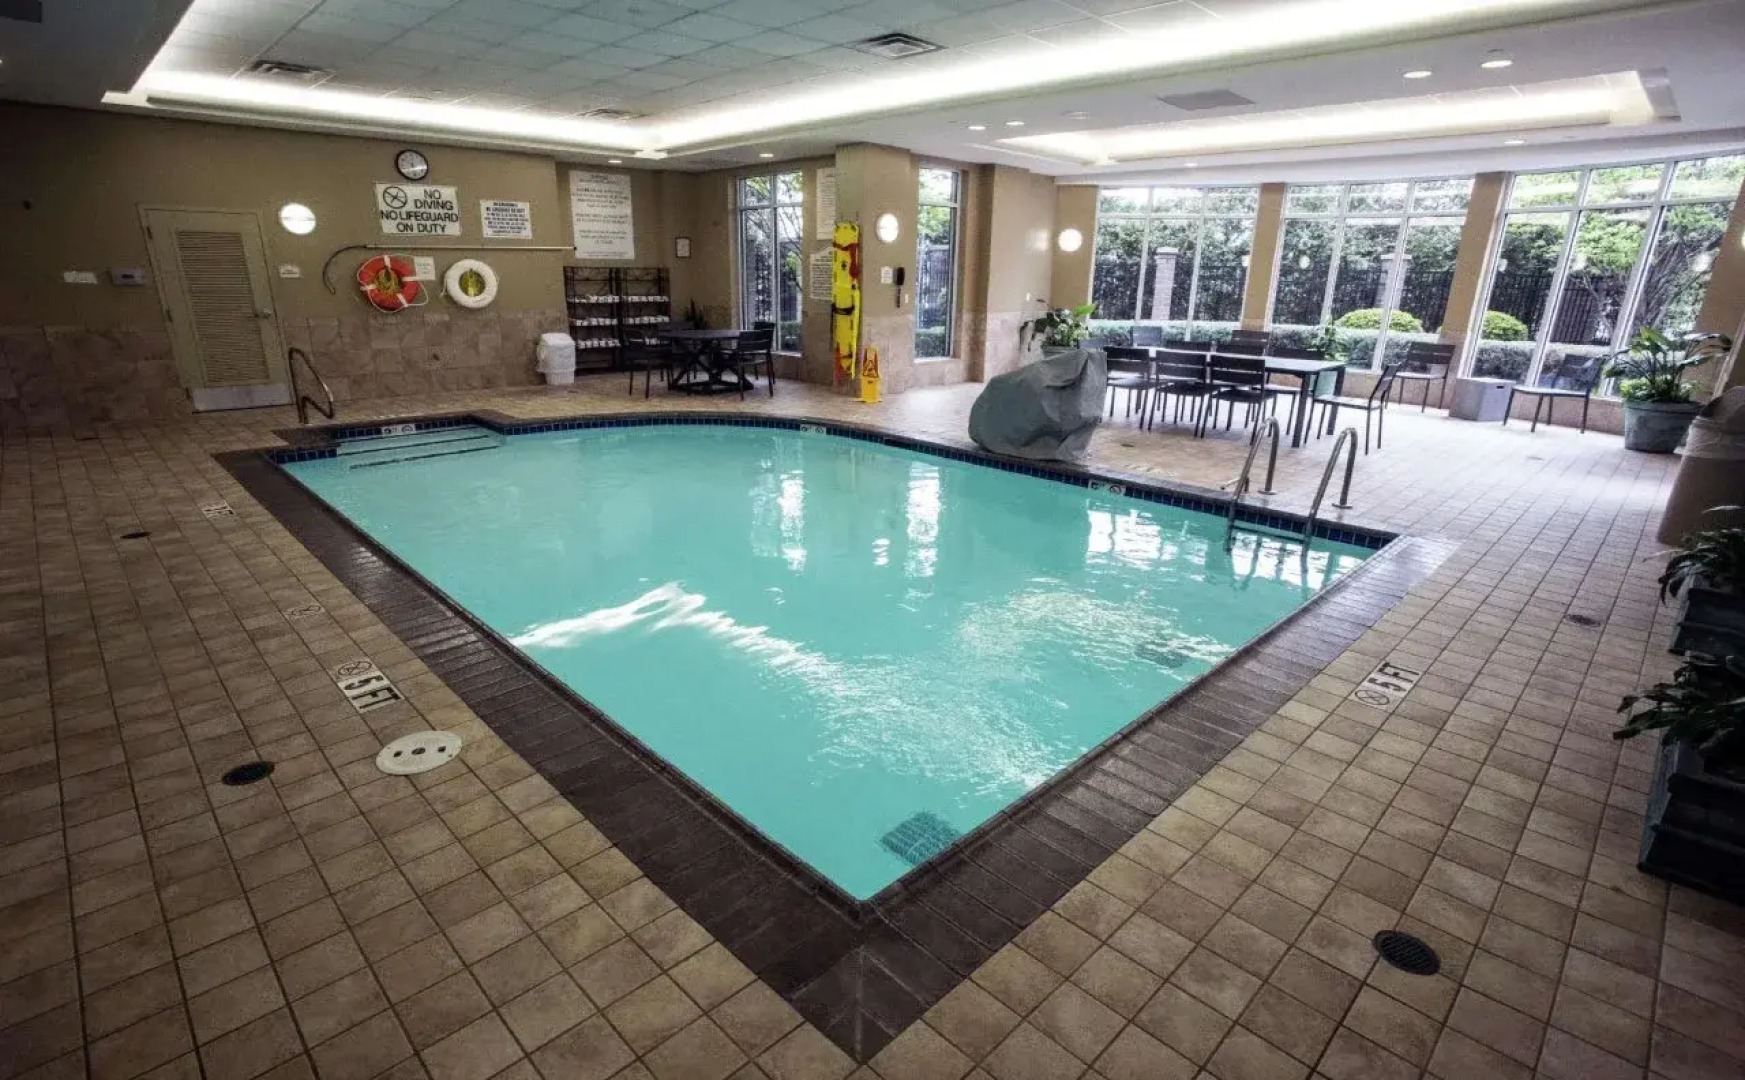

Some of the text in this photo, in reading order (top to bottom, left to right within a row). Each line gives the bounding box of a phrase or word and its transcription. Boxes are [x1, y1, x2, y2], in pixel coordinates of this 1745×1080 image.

[424, 188, 441, 200] NO
[414, 199, 454, 211] DIVING
[381, 210, 459, 222] NO LIFEGUARD
[396, 222, 447, 233] ON DUTY
[1377, 662, 1420, 683] FT
[344, 674, 401, 709] 5 FT
